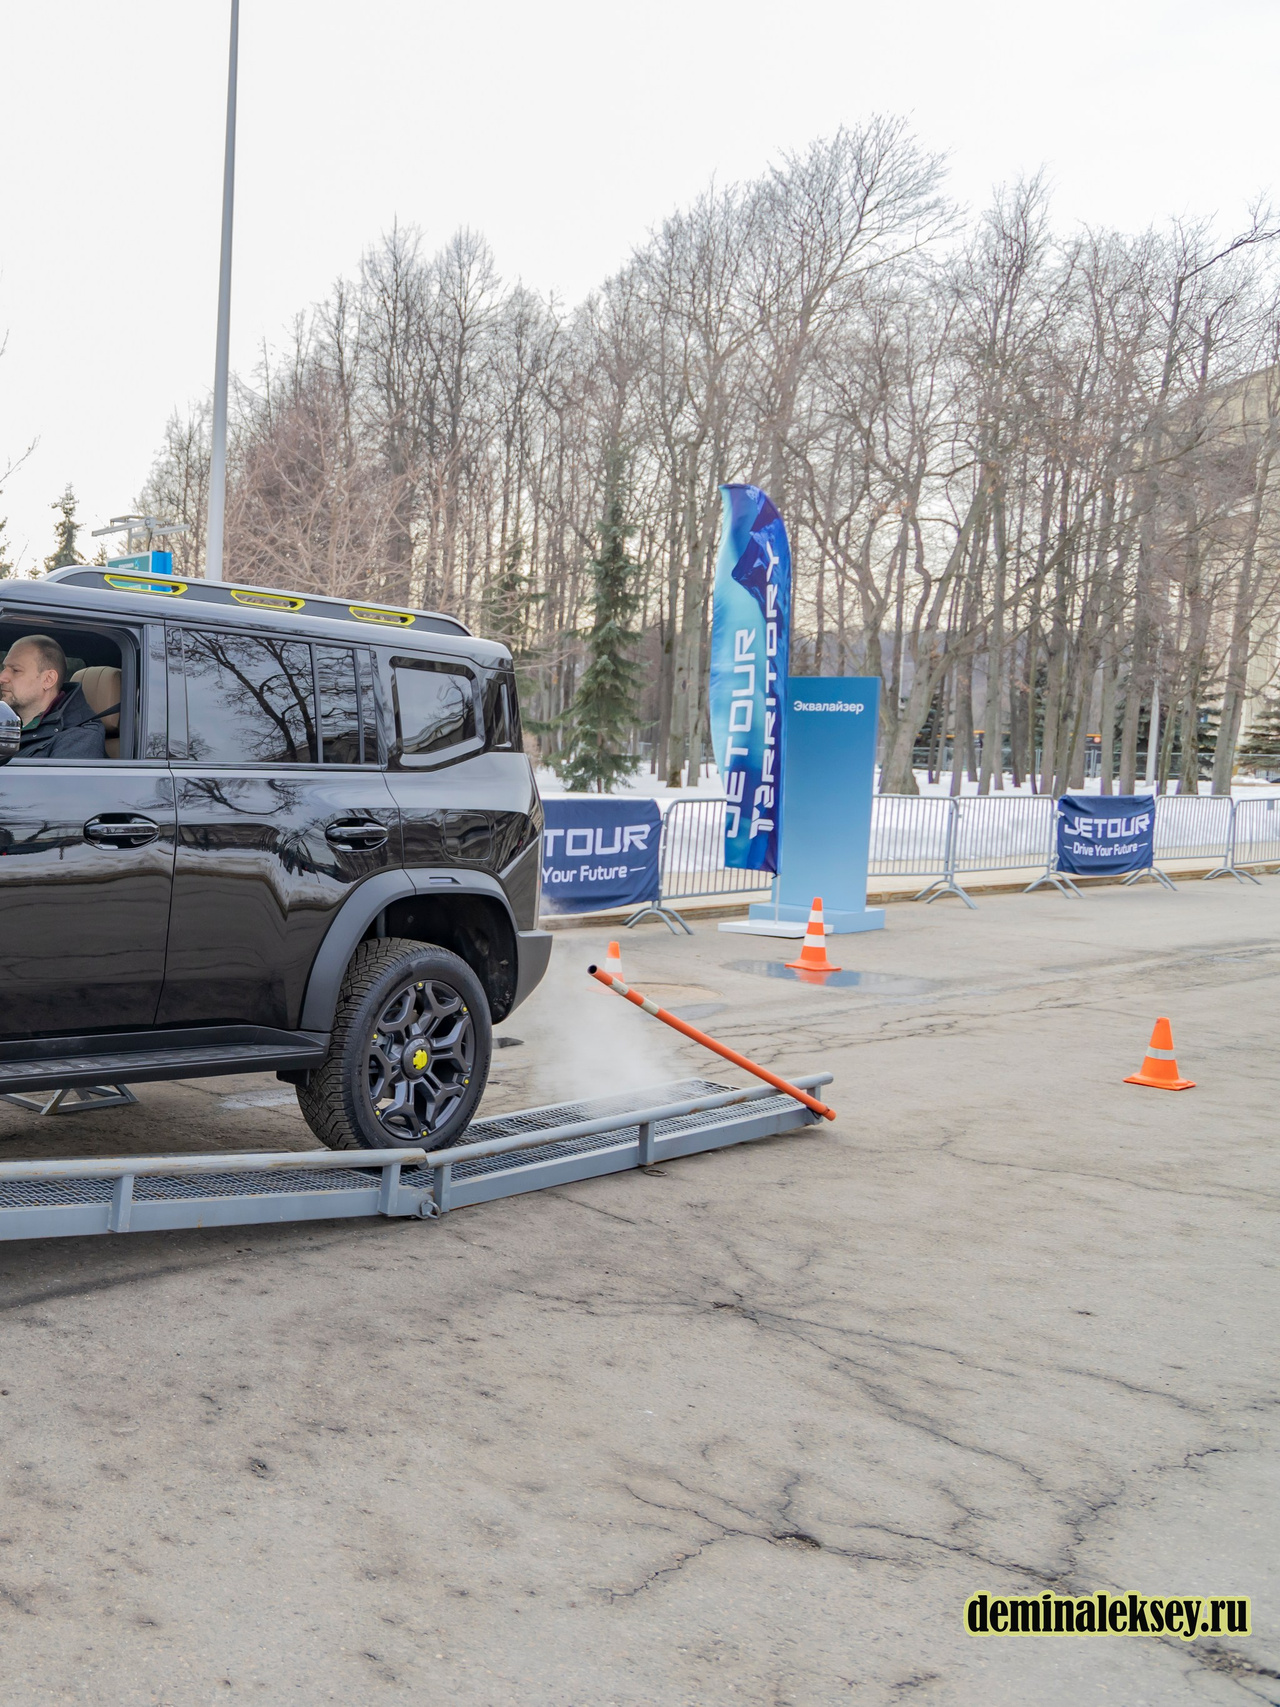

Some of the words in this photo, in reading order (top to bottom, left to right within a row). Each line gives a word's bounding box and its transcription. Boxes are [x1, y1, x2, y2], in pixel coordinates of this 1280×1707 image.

[793, 700, 865, 715] Эквалайзер
[724, 627, 756, 838] JETOUR
[1064, 813, 1151, 838] JETOUR
[1073, 842, 1094, 856] Drive
[1095, 844, 1113, 856] Your
[1113, 843, 1138, 855] Future
[542, 866, 577, 884] Your
[580, 865, 627, 882] Future
